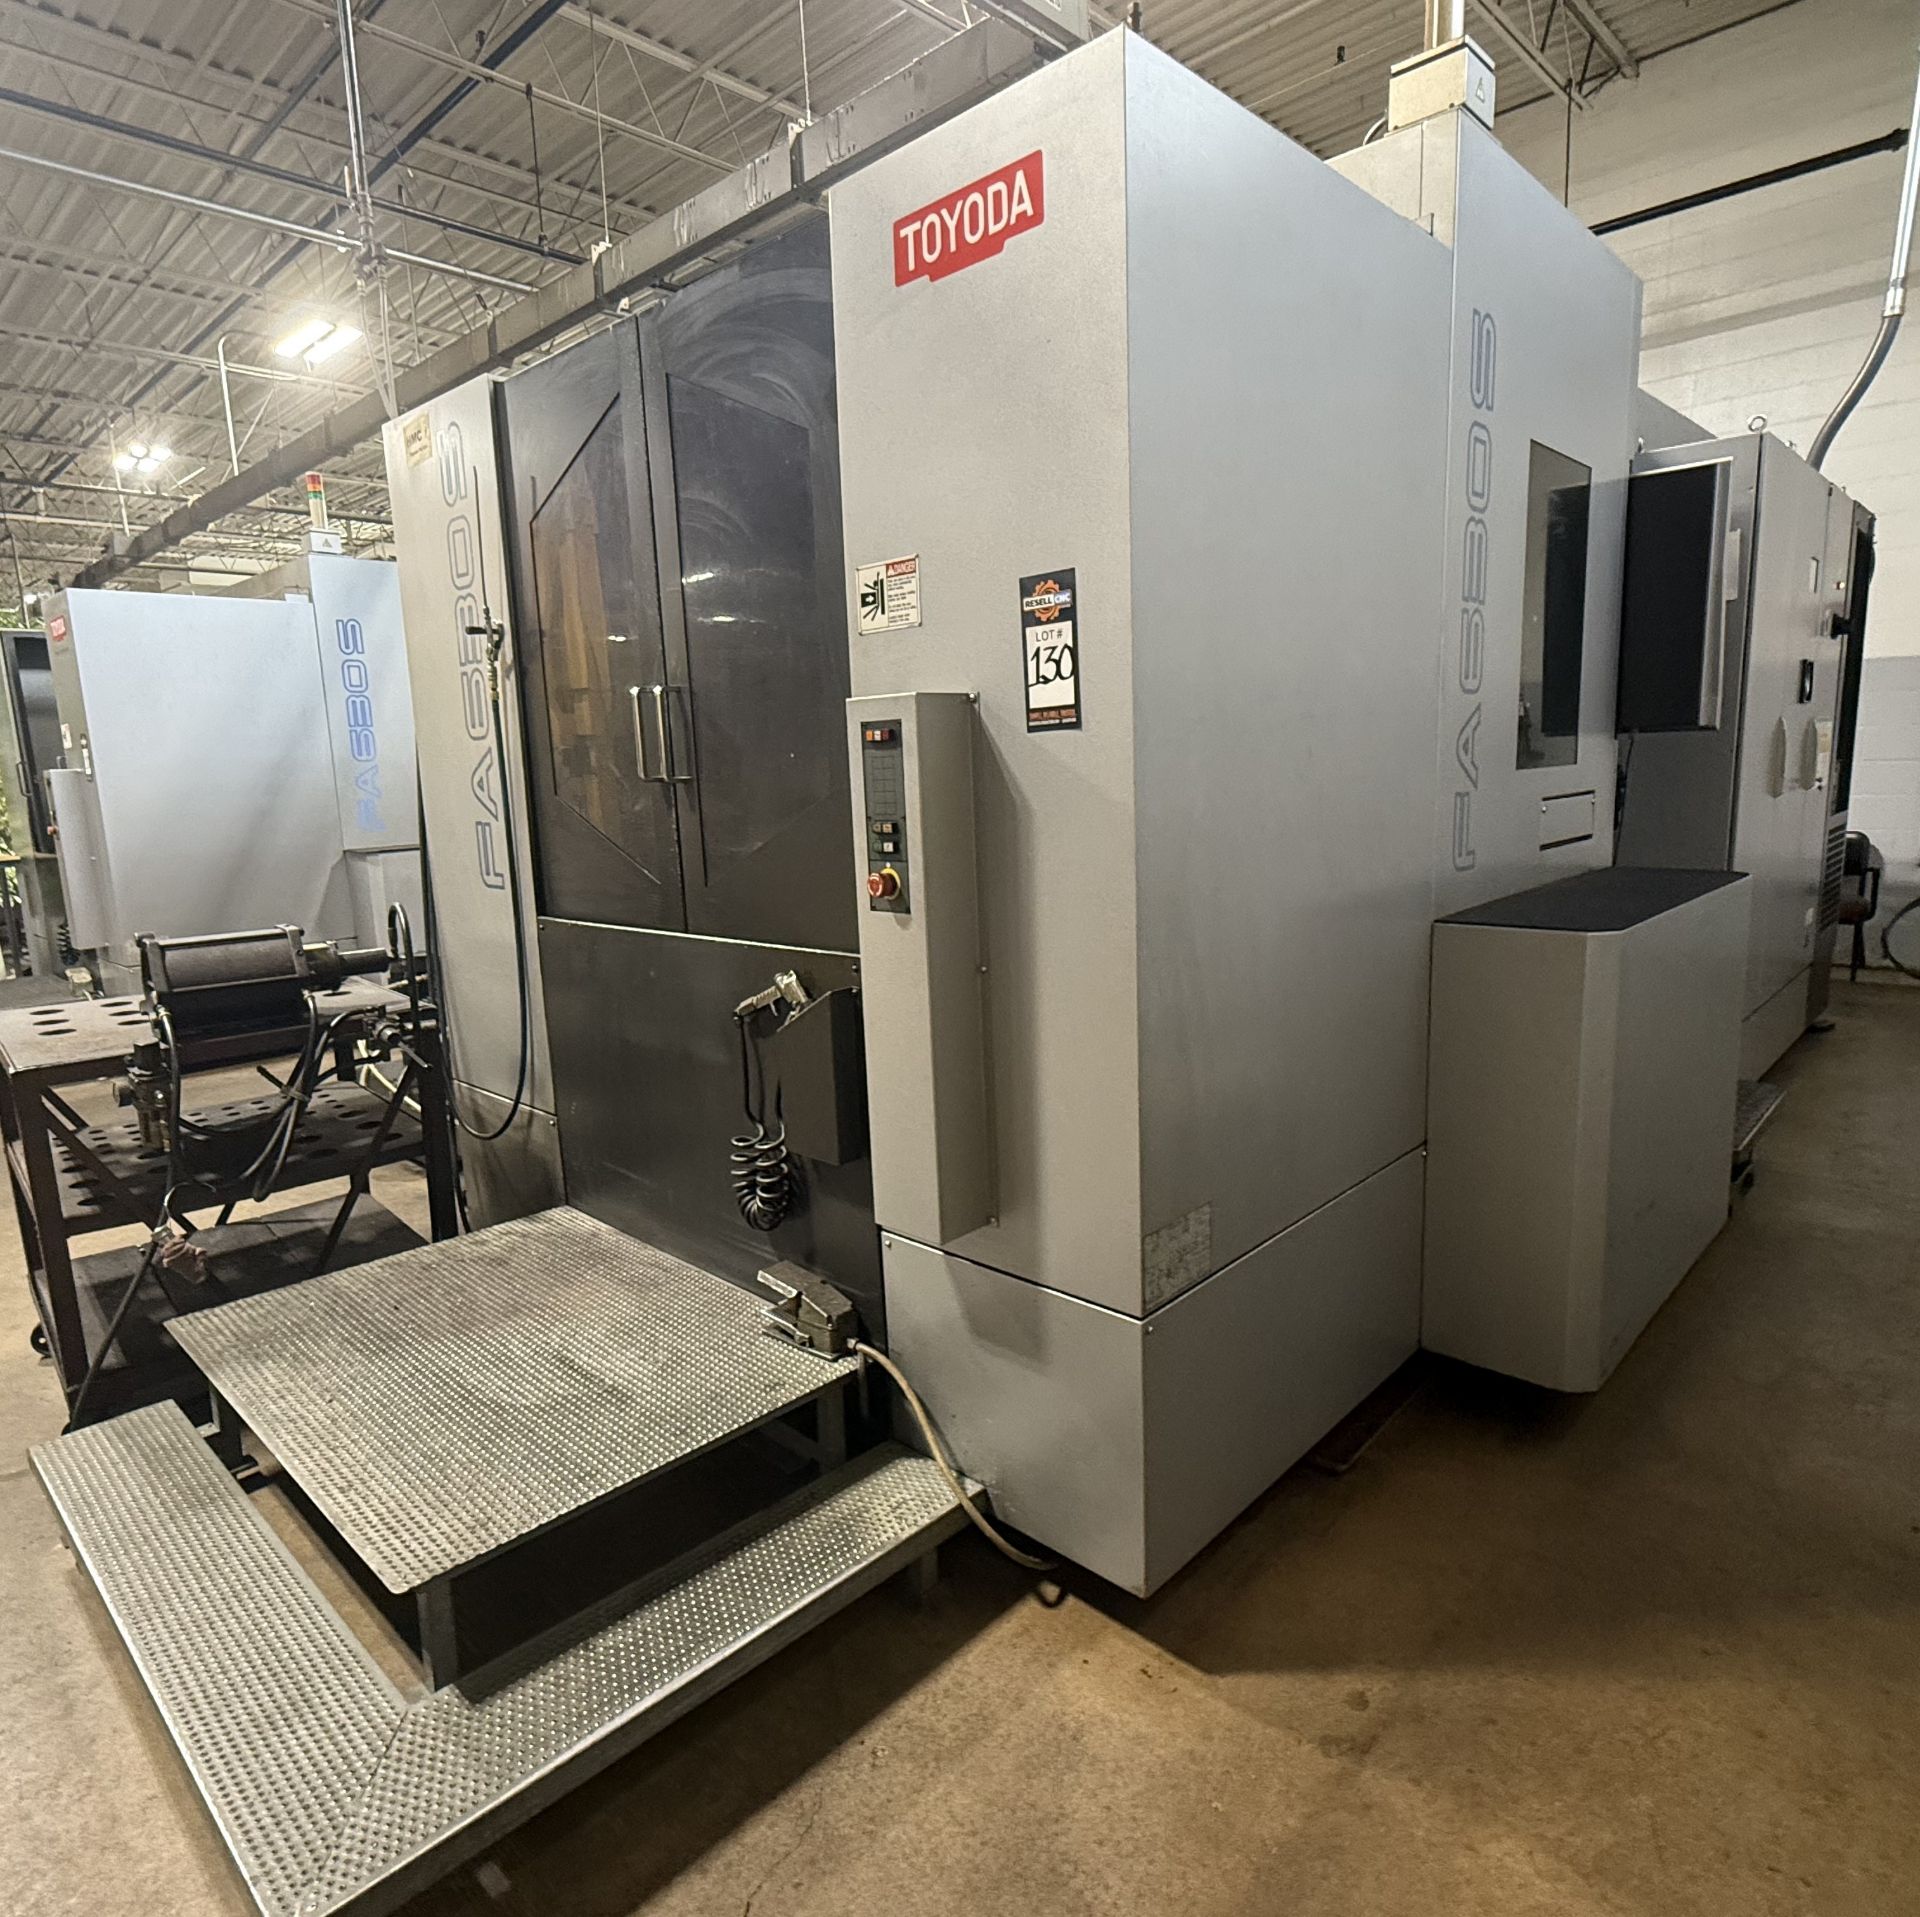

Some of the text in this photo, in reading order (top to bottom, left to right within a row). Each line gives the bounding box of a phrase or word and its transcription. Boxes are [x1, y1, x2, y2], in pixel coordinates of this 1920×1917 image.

[900, 170, 1034, 271] TOYODA
[1025, 597, 1052, 608] RESELL
[1035, 629, 1063, 642] LOT #
[1030, 643, 1075, 687] 130
